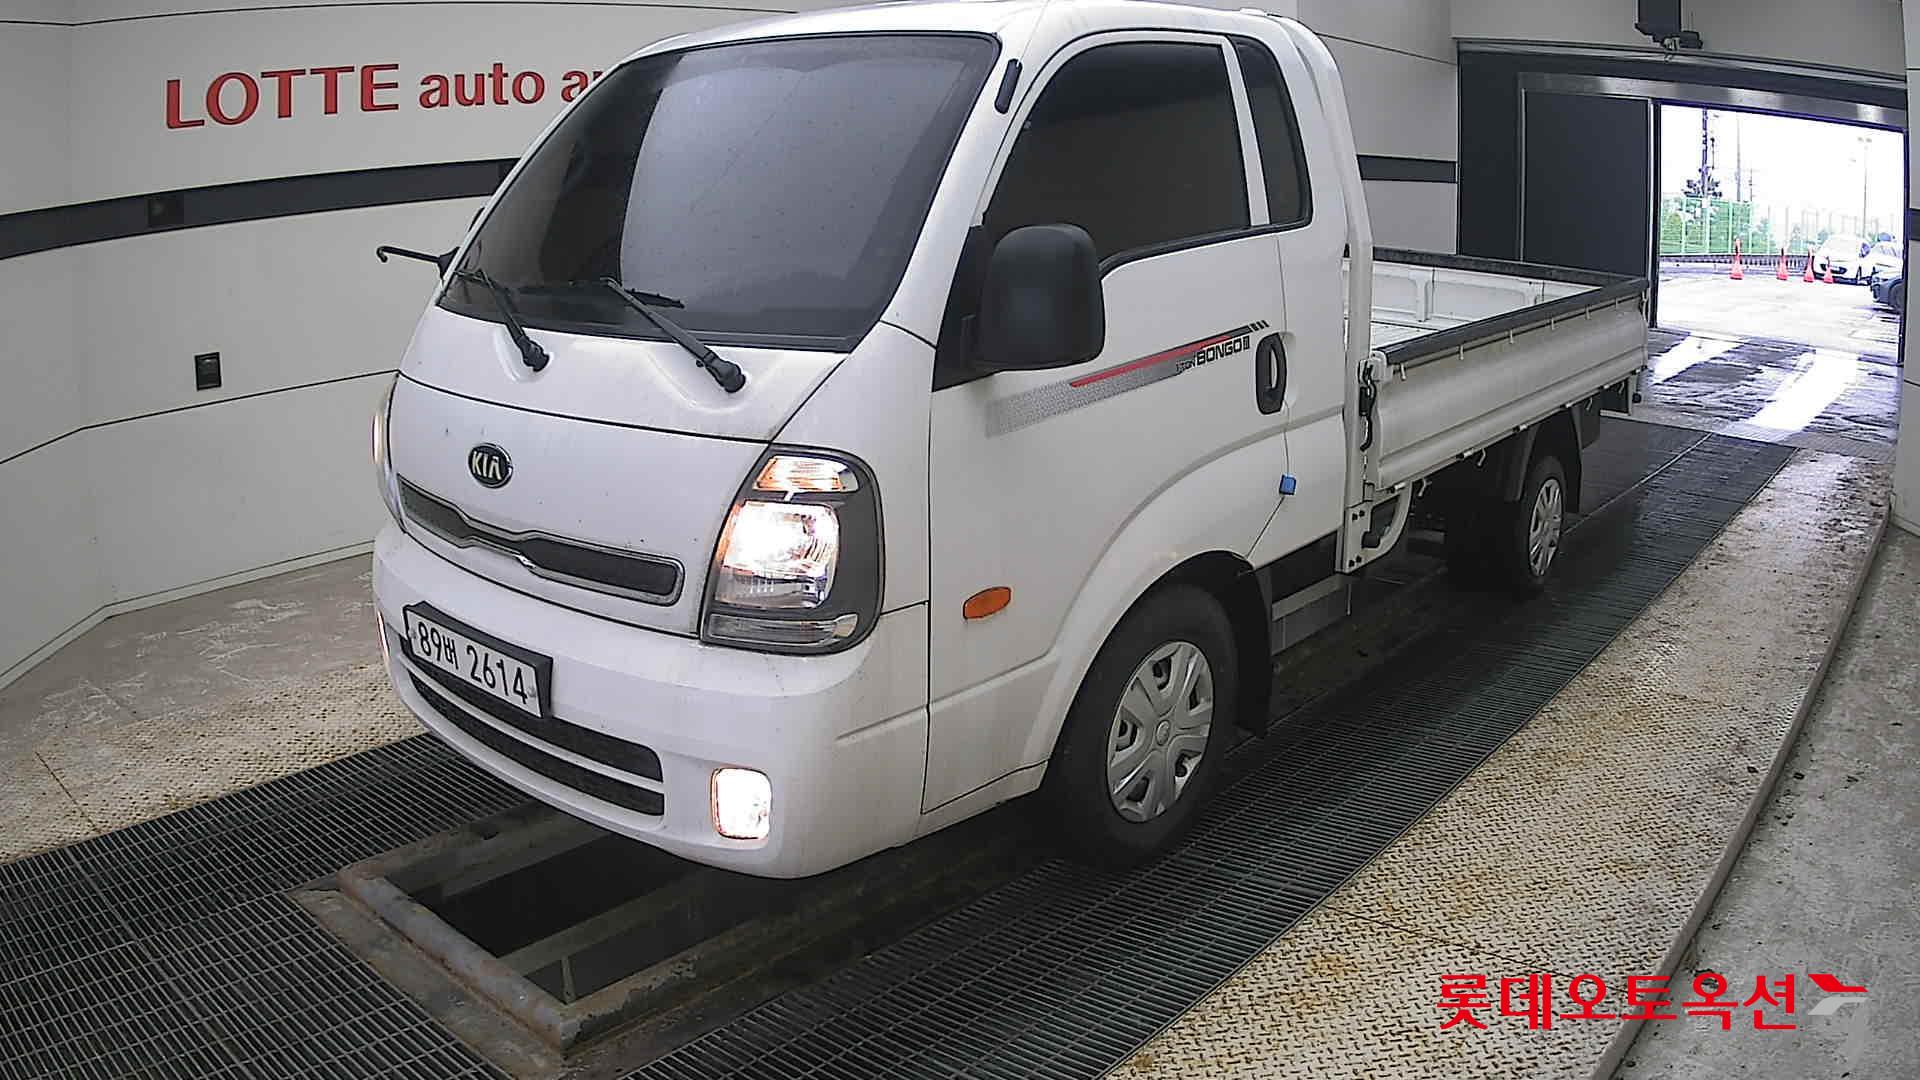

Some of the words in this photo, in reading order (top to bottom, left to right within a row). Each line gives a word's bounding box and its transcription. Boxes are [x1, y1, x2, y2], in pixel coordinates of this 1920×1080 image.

[165, 64, 399, 129] LOTTE
[418, 62, 545, 108] auto
[561, 70, 604, 103] a
[470, 450, 503, 480] KIA
[466, 645, 528, 705] 2614
